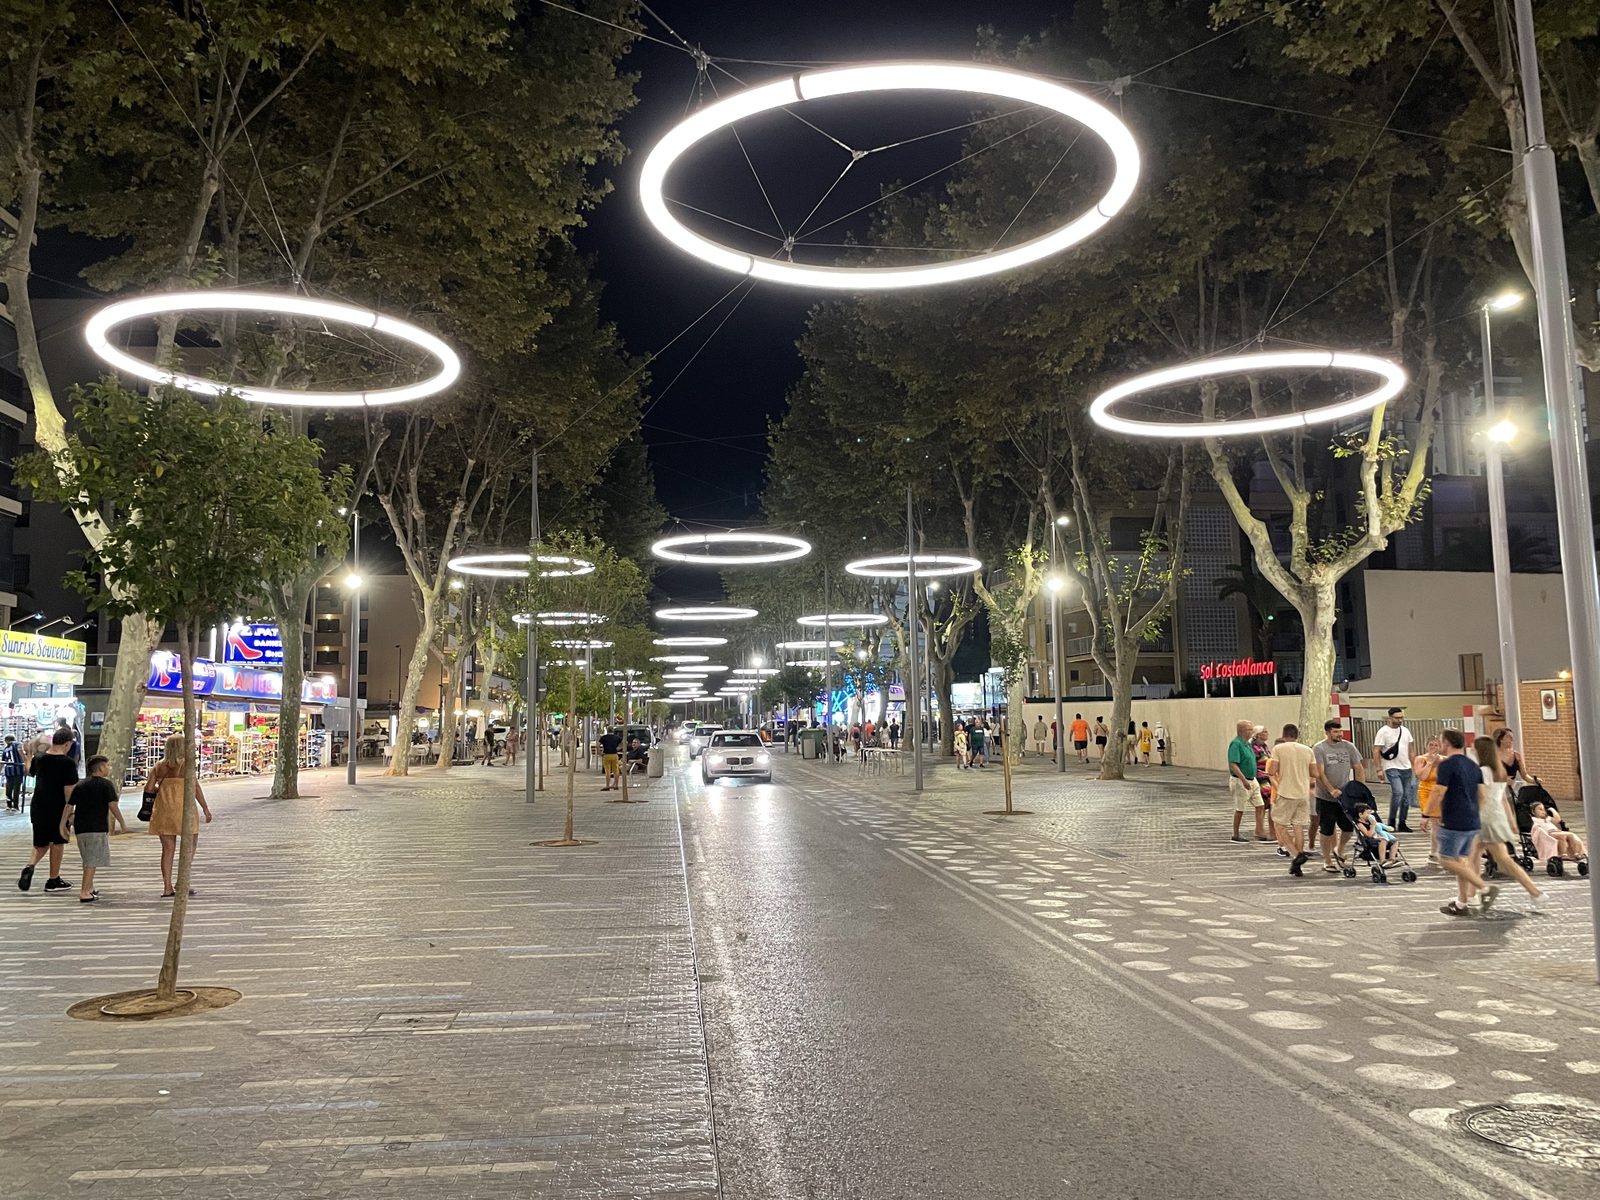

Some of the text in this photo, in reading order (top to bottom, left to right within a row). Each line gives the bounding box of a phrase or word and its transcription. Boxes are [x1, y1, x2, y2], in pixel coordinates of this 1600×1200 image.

[240, 626, 279, 637] ZAPAT
[2, 633, 76, 661] Sunrise Souvenirs
[1200, 657, 1274, 679] Sol Costablanca
